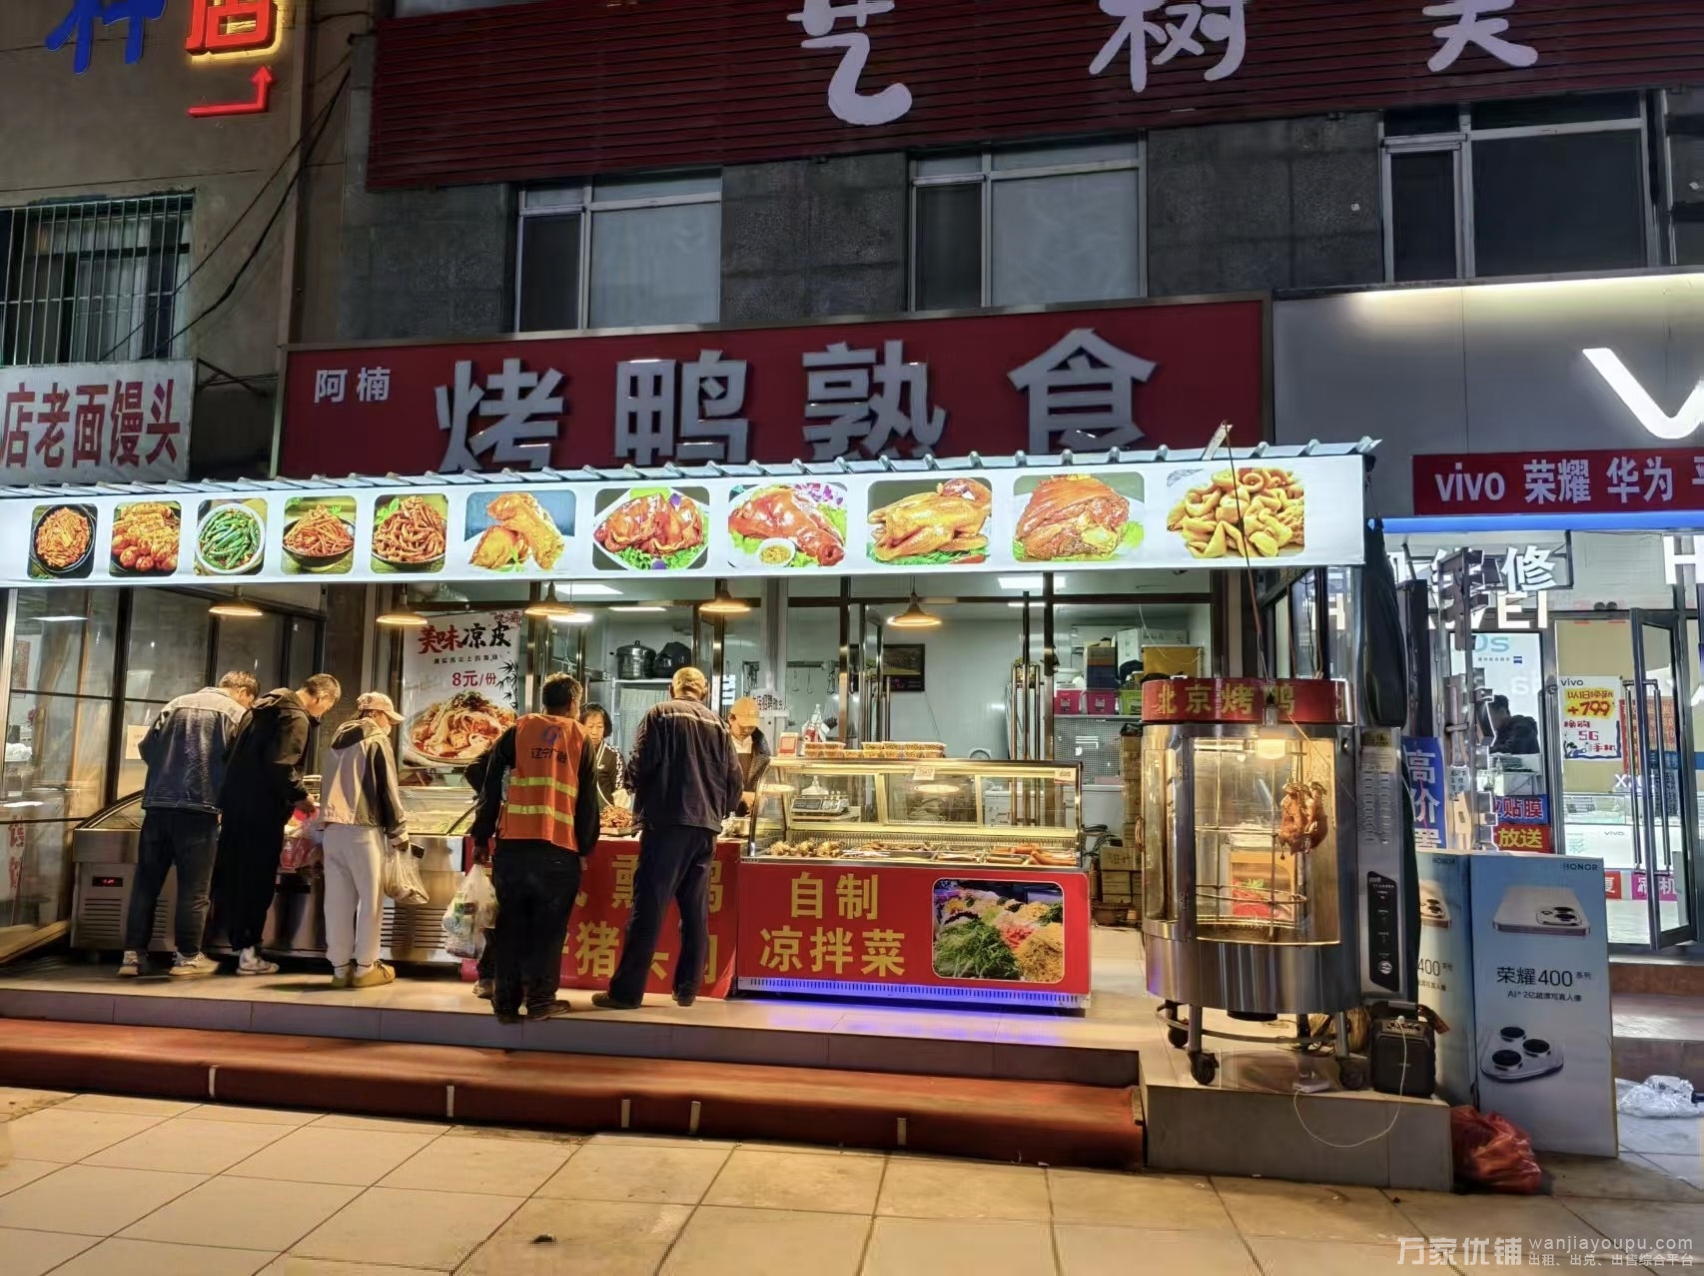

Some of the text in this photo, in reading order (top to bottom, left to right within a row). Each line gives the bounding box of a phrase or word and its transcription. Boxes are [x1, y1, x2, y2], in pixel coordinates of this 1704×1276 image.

[314, 327, 1158, 474] 阿楠 烤鸭熟食
[1, 378, 181, 471] 店老面馒头
[1435, 462, 1506, 502] vivo
[1523, 458, 1592, 505] 荣耀
[1606, 455, 1674, 504] 华为
[417, 620, 512, 655] 美味凉皮
[452, 669, 497, 688] 8元/份
[1561, 678, 1584, 687] vivo
[1578, 730, 1599, 741] 5G
[1494, 827, 1543, 849] 放送
[1563, 862, 1598, 872] HONOR
[790, 870, 879, 920] 自制
[759, 925, 906, 977] 凉拌菜
